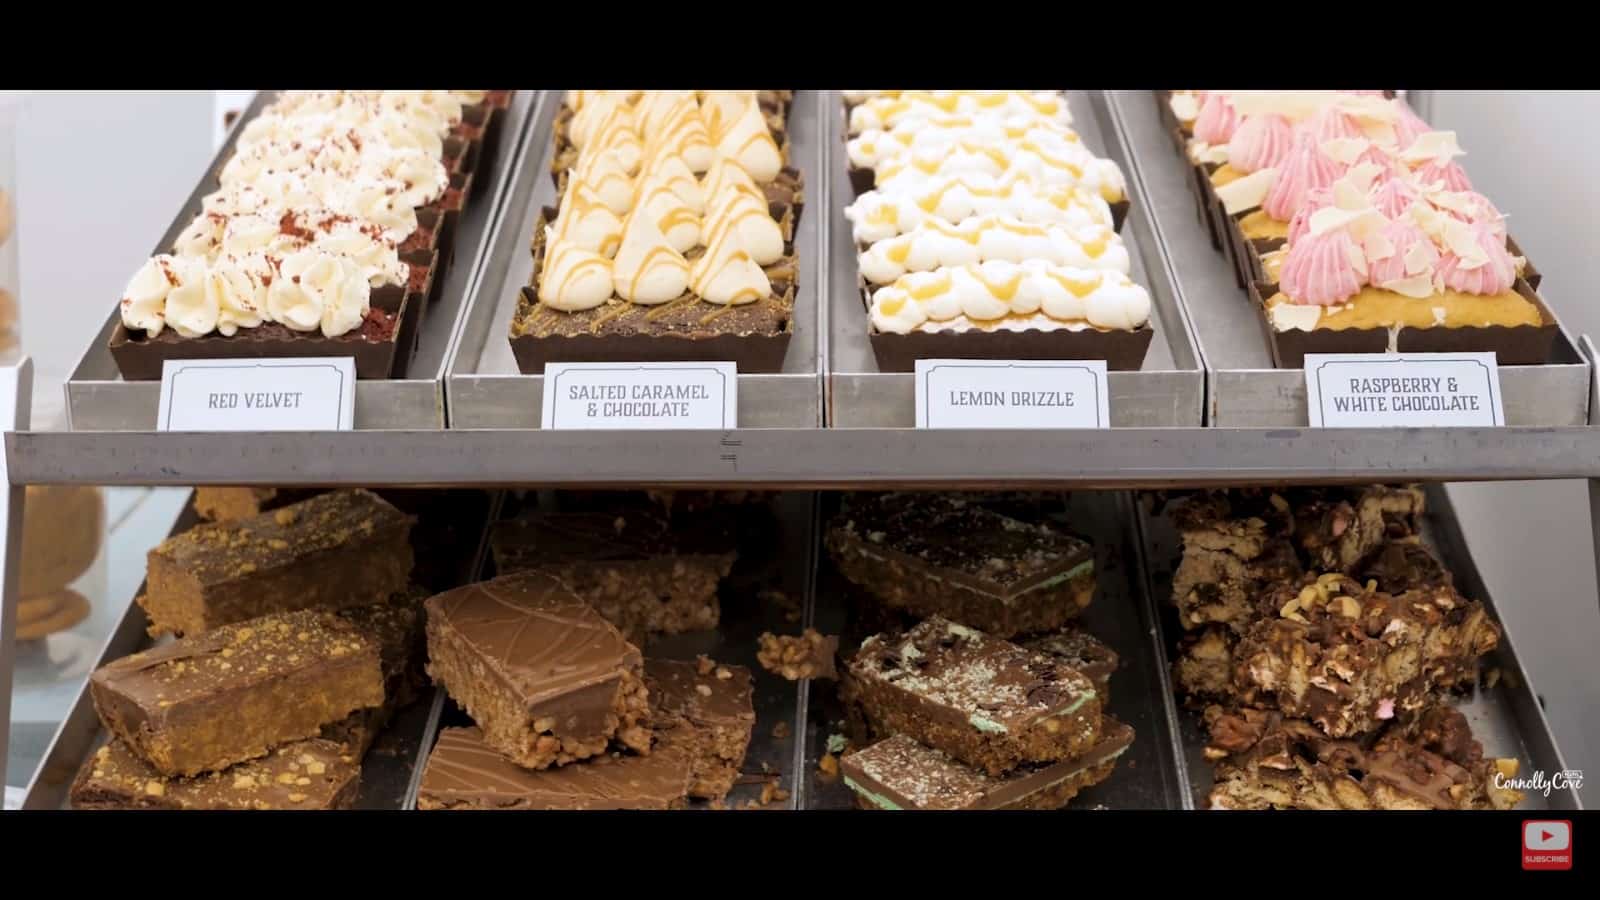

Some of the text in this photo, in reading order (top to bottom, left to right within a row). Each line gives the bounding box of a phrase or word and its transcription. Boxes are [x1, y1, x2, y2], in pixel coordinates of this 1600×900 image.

[569, 384, 709, 400] SALTED CARAMEL
[1349, 377, 1458, 393] RASPBERRY &
[208, 392, 303, 409] RED VELVET
[950, 391, 1075, 407] LEMON DRIZZLE
[1334, 395, 1480, 412] WHITE CHOCOLATE
[587, 402, 689, 417] & CHOCOLATE
